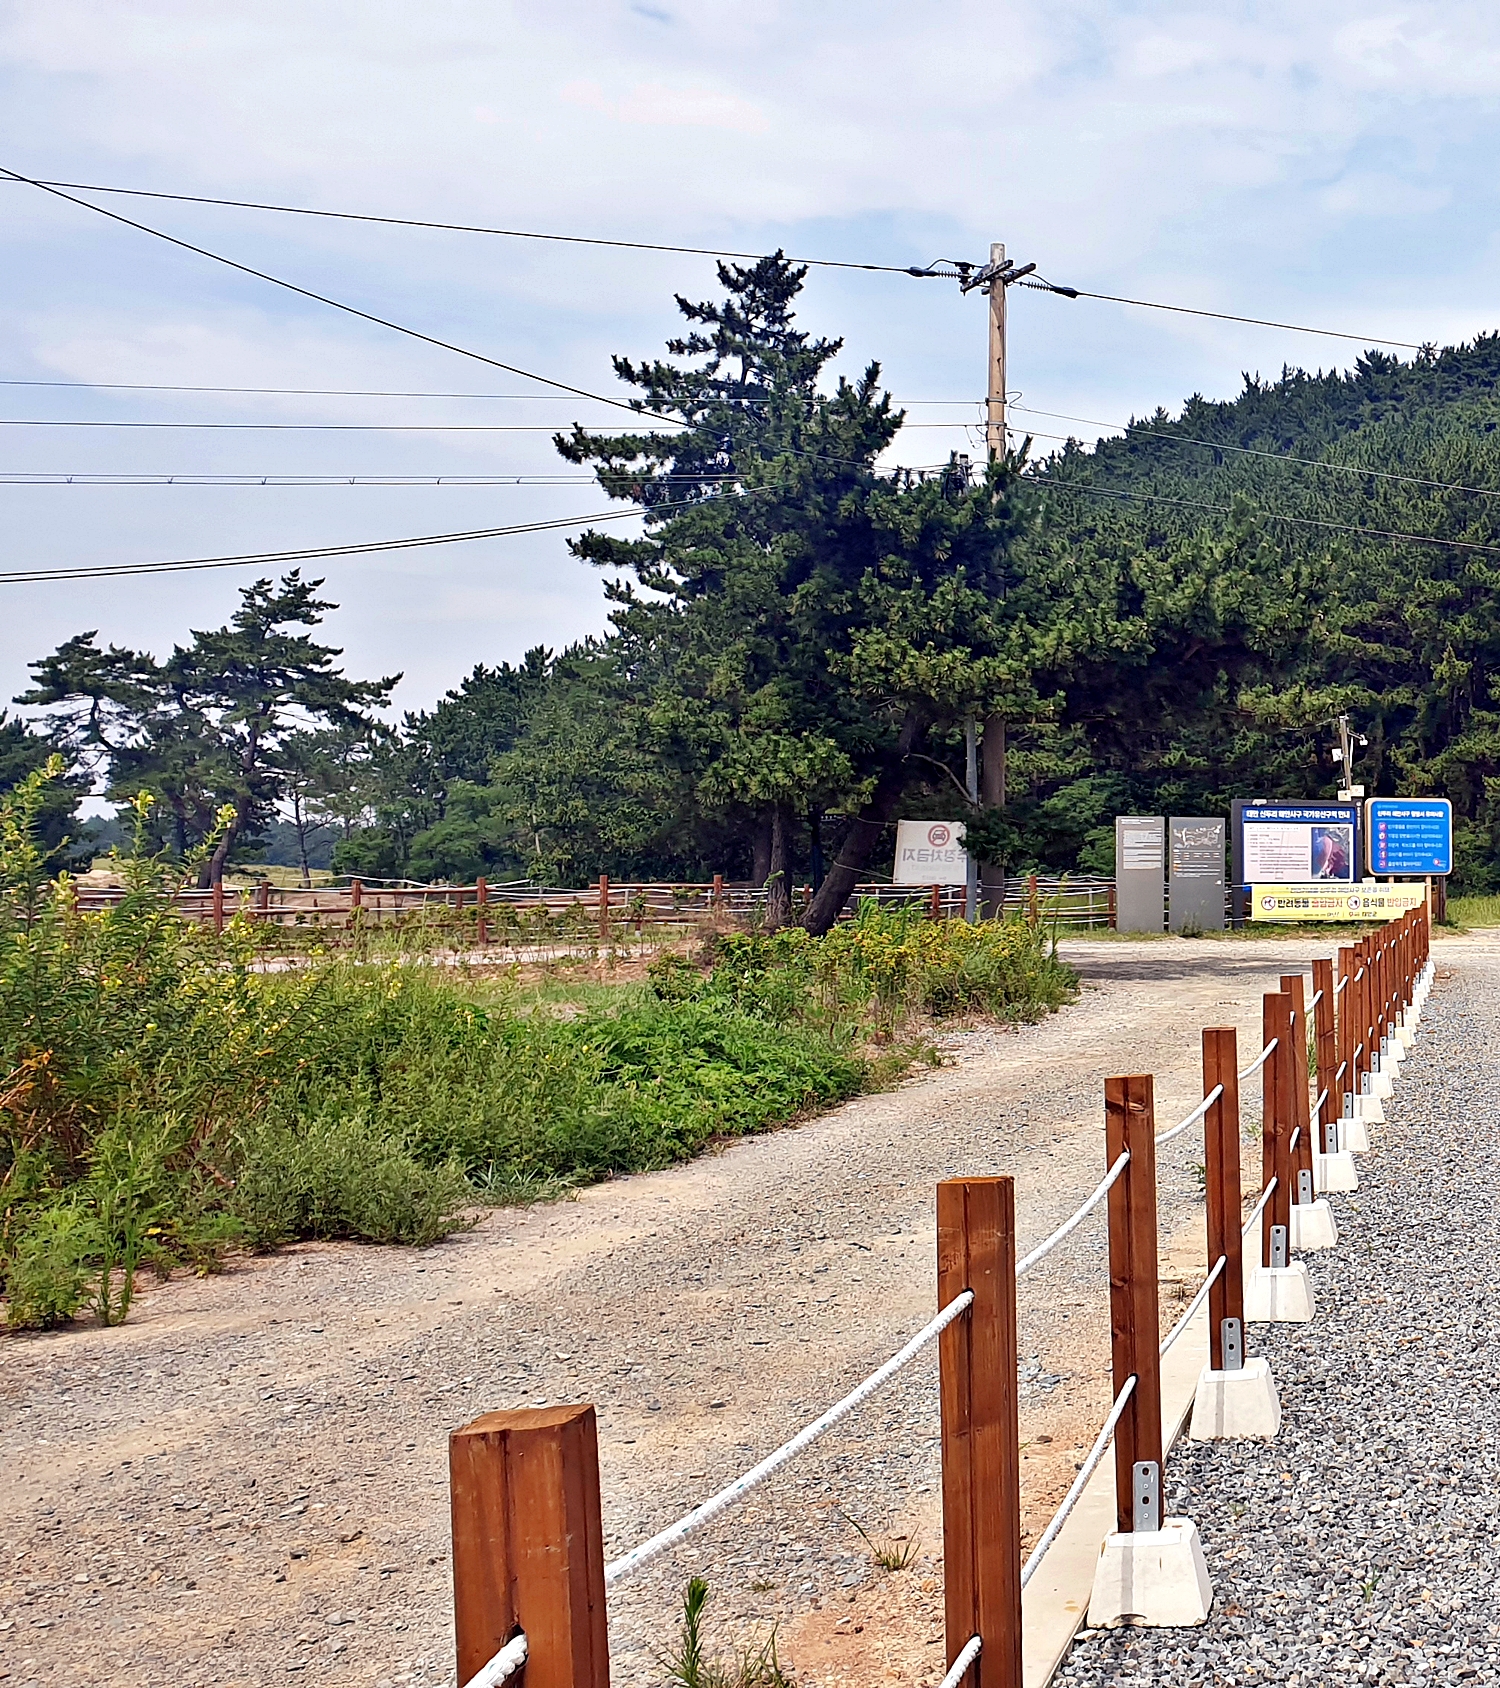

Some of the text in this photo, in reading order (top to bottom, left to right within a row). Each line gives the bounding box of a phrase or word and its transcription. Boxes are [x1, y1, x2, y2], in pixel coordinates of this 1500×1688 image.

[1278, 810, 1302, 819] 해안사구
[1338, 810, 1351, 819] 안내
[1277, 897, 1417, 908] 반려동물 출입금지 음식물 반입금지
